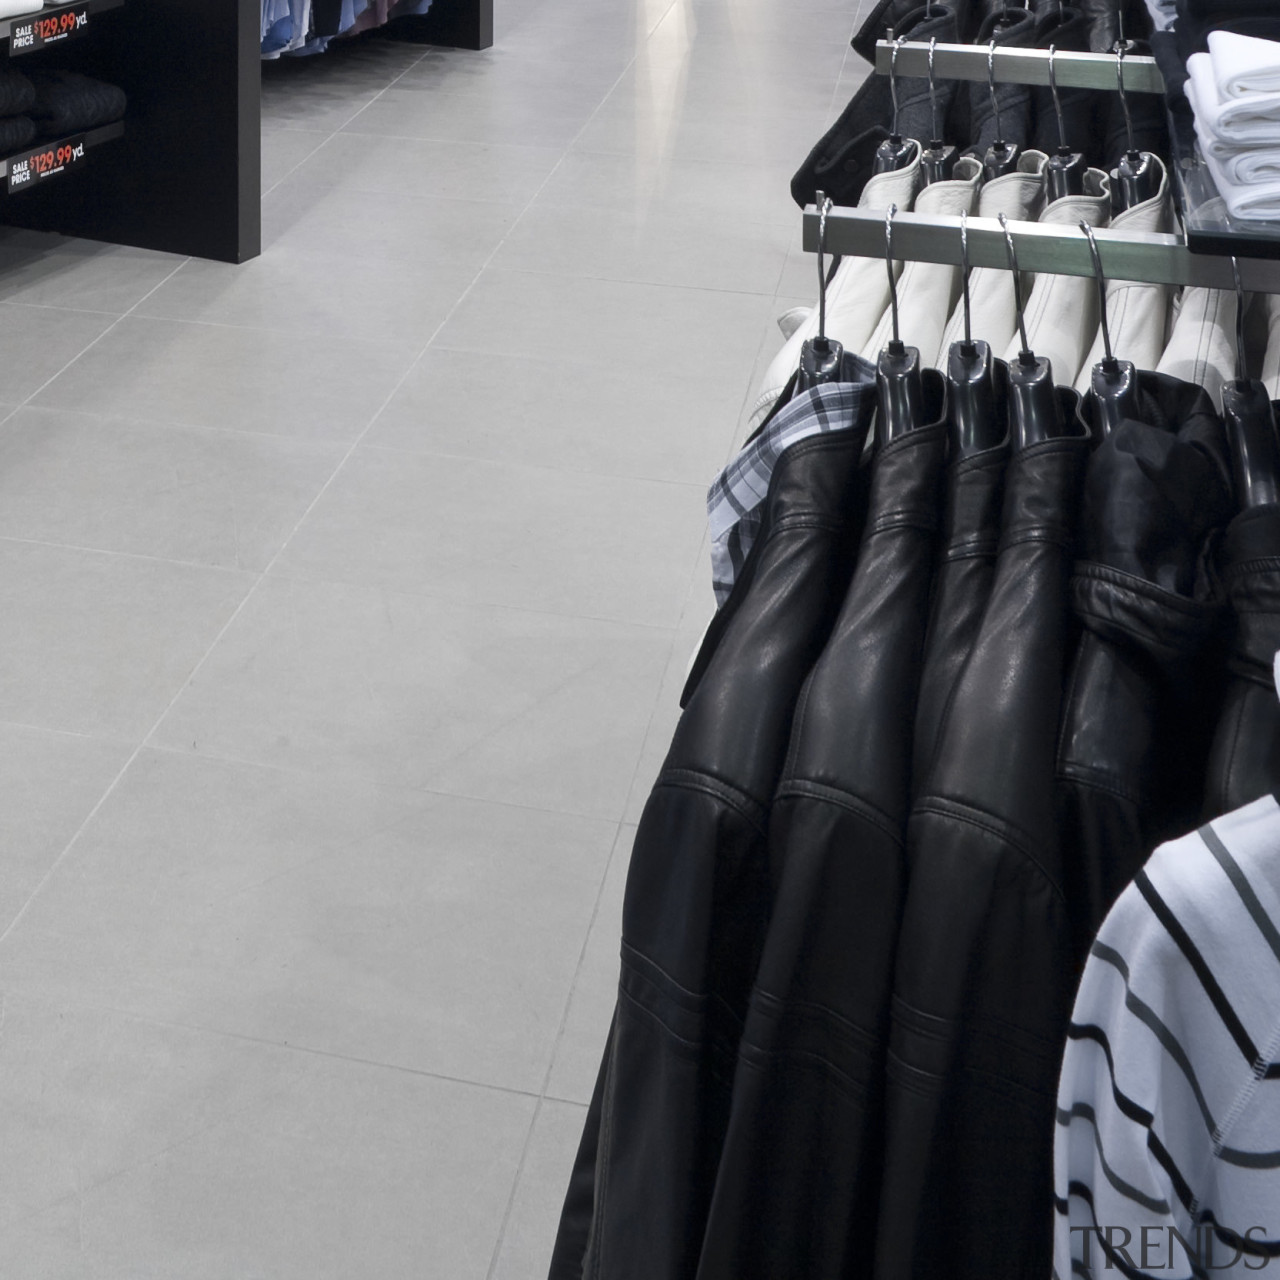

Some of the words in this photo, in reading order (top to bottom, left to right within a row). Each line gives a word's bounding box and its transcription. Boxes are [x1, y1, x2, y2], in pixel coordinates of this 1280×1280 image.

[15, 25, 32, 38] SALE
[34, 12, 75, 38] $129.99
[75, 11, 87, 29] yd.
[13, 34, 34, 49] PRICE
[29, 144, 72, 174] $129.99
[72, 142, 84, 162] yd.
[12, 160, 28, 175] SALE
[11, 170, 30, 186] PRICE
